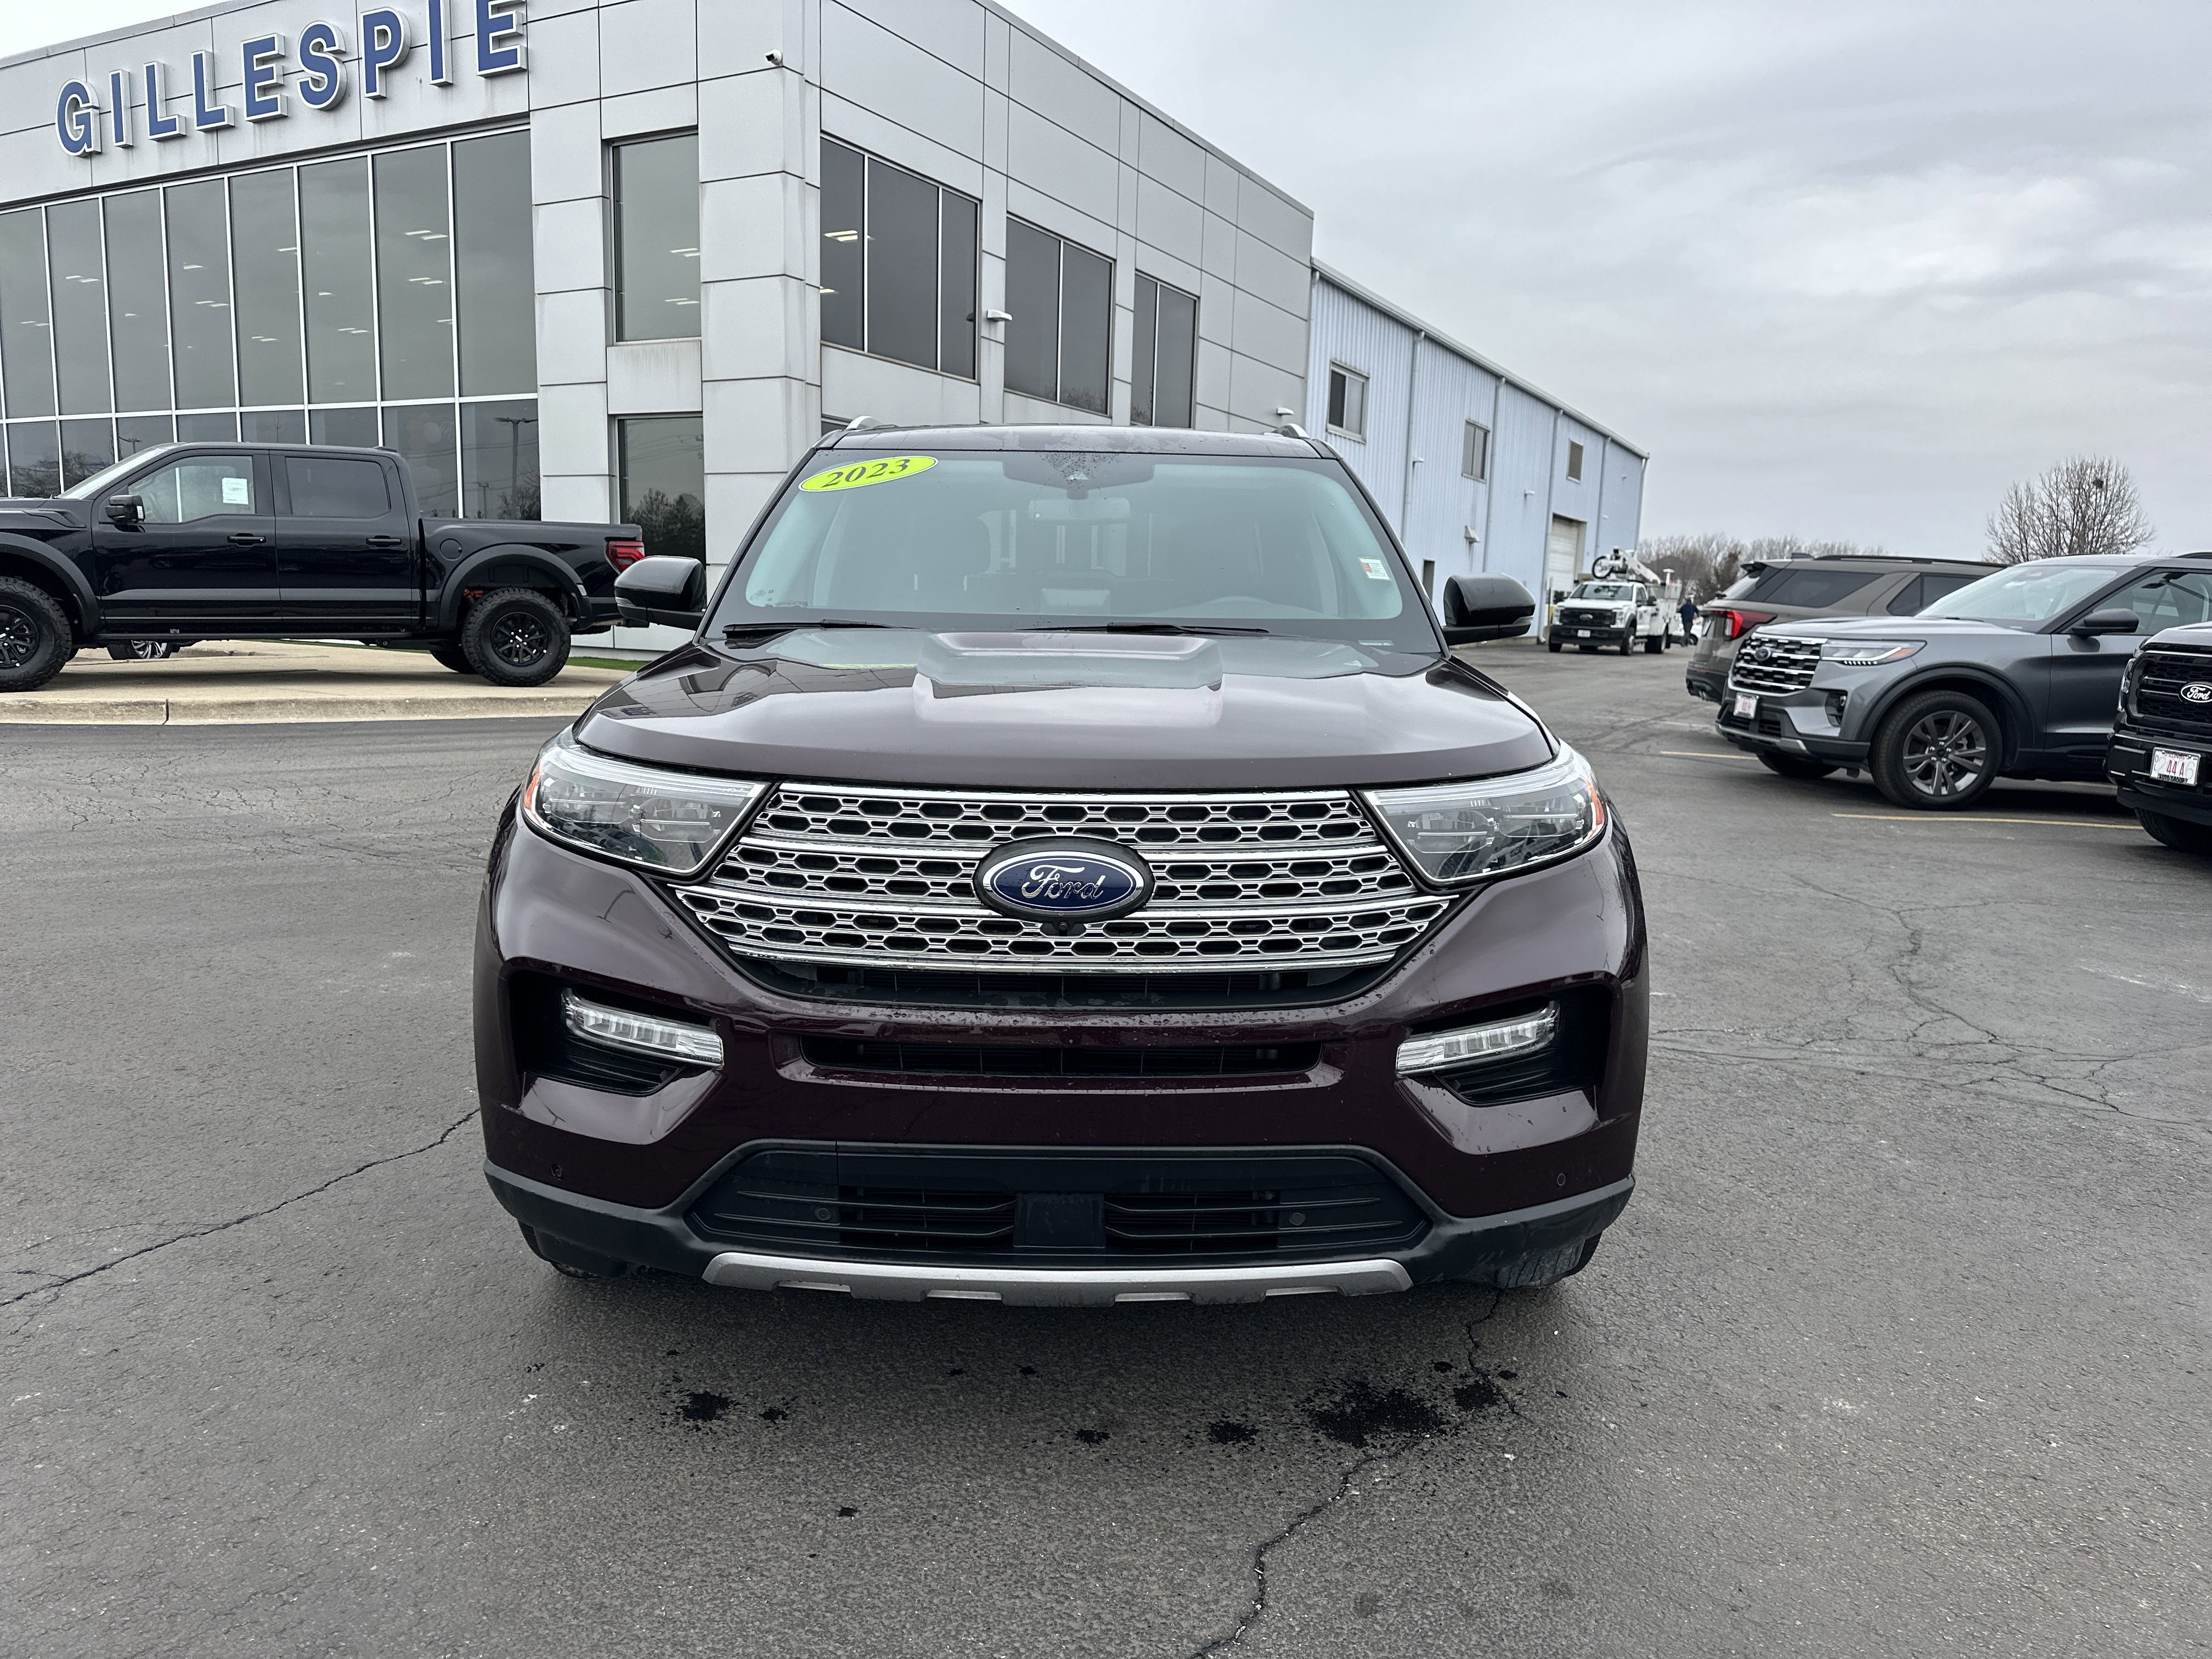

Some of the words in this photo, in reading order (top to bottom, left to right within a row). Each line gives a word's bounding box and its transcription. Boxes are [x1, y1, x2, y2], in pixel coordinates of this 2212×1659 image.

[55, 0, 527, 158] GILLESPIE
[821, 459, 910, 488] 2023
[2187, 686, 2211, 700] Ford
[1021, 864, 1106, 900] Ford
